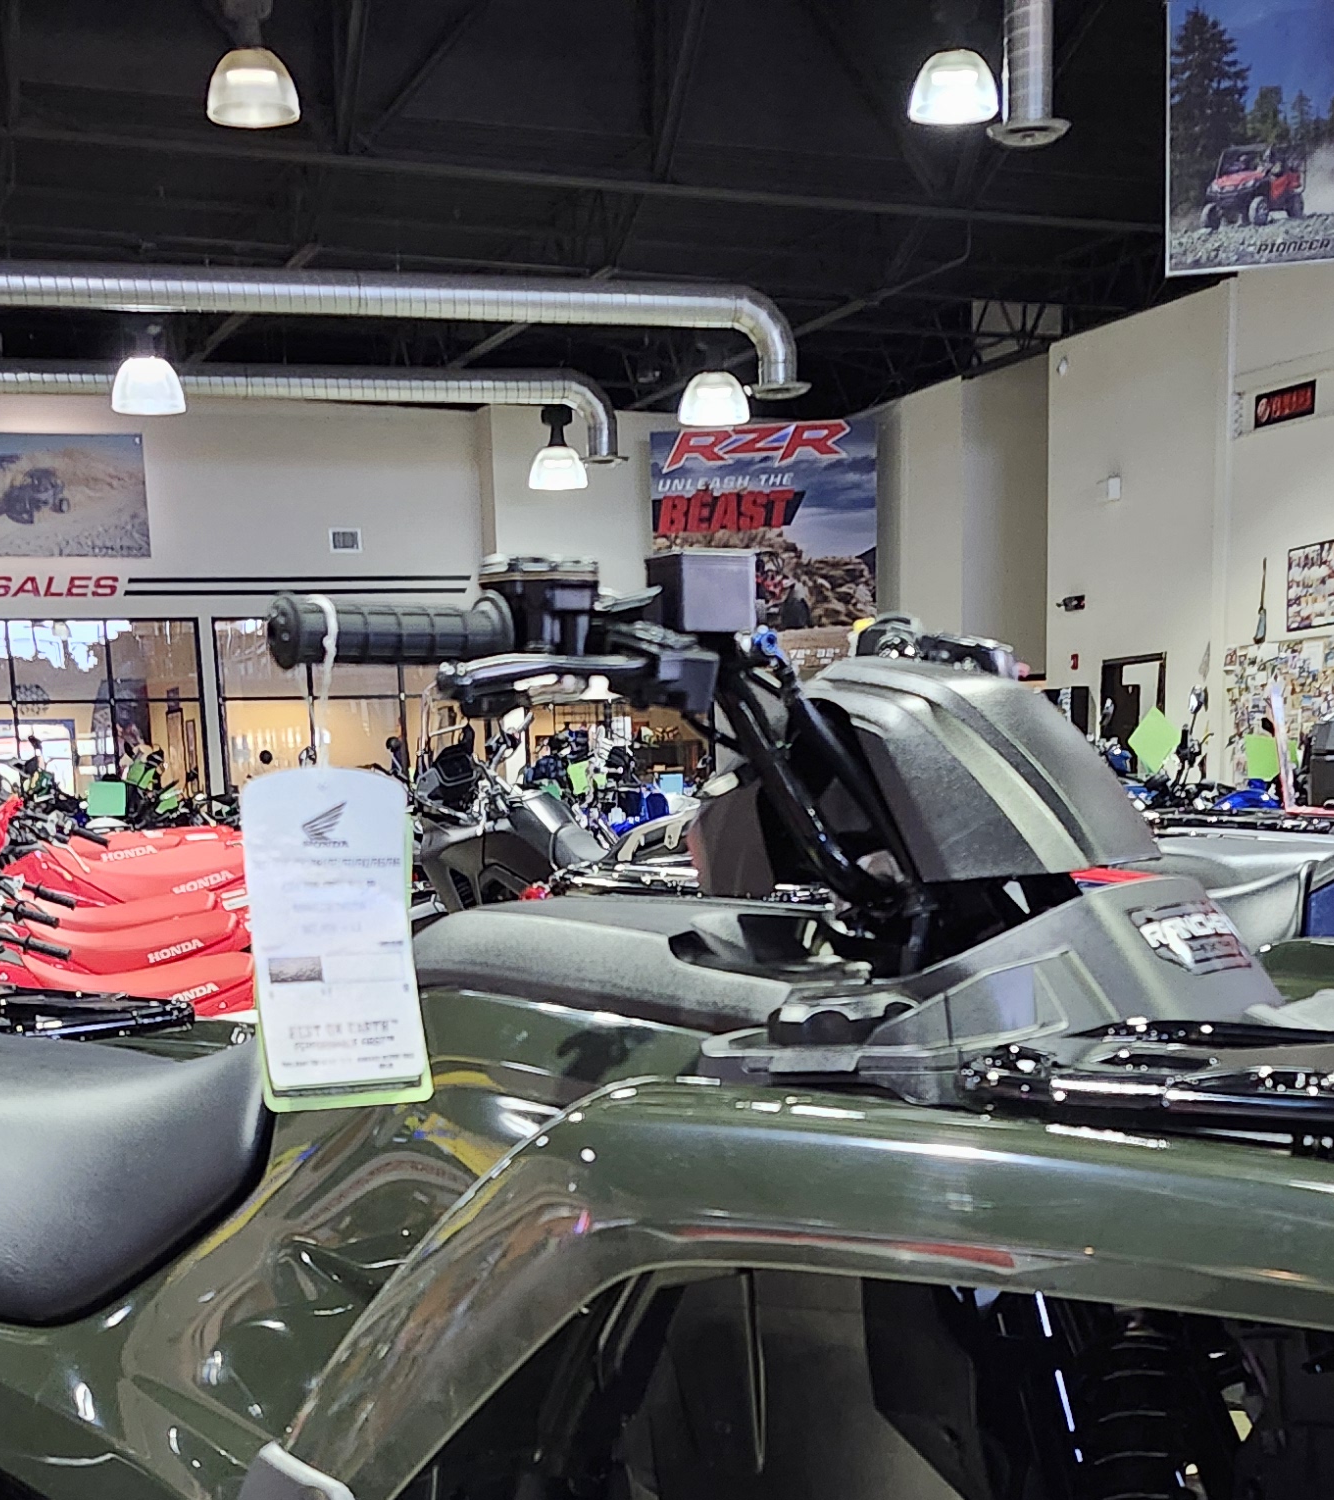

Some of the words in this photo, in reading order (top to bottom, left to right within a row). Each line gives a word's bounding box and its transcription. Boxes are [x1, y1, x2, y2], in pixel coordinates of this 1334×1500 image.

[662, 419, 851, 474] RZR
[657, 474, 750, 493] UNLEASH
[758, 471, 795, 487] THE
[656, 488, 795, 537] BEAST
[100, 844, 158, 863] HONDA
[171, 869, 235, 895] HONDA
[146, 938, 205, 965] HONDA
[168, 981, 220, 1004] ONDA
